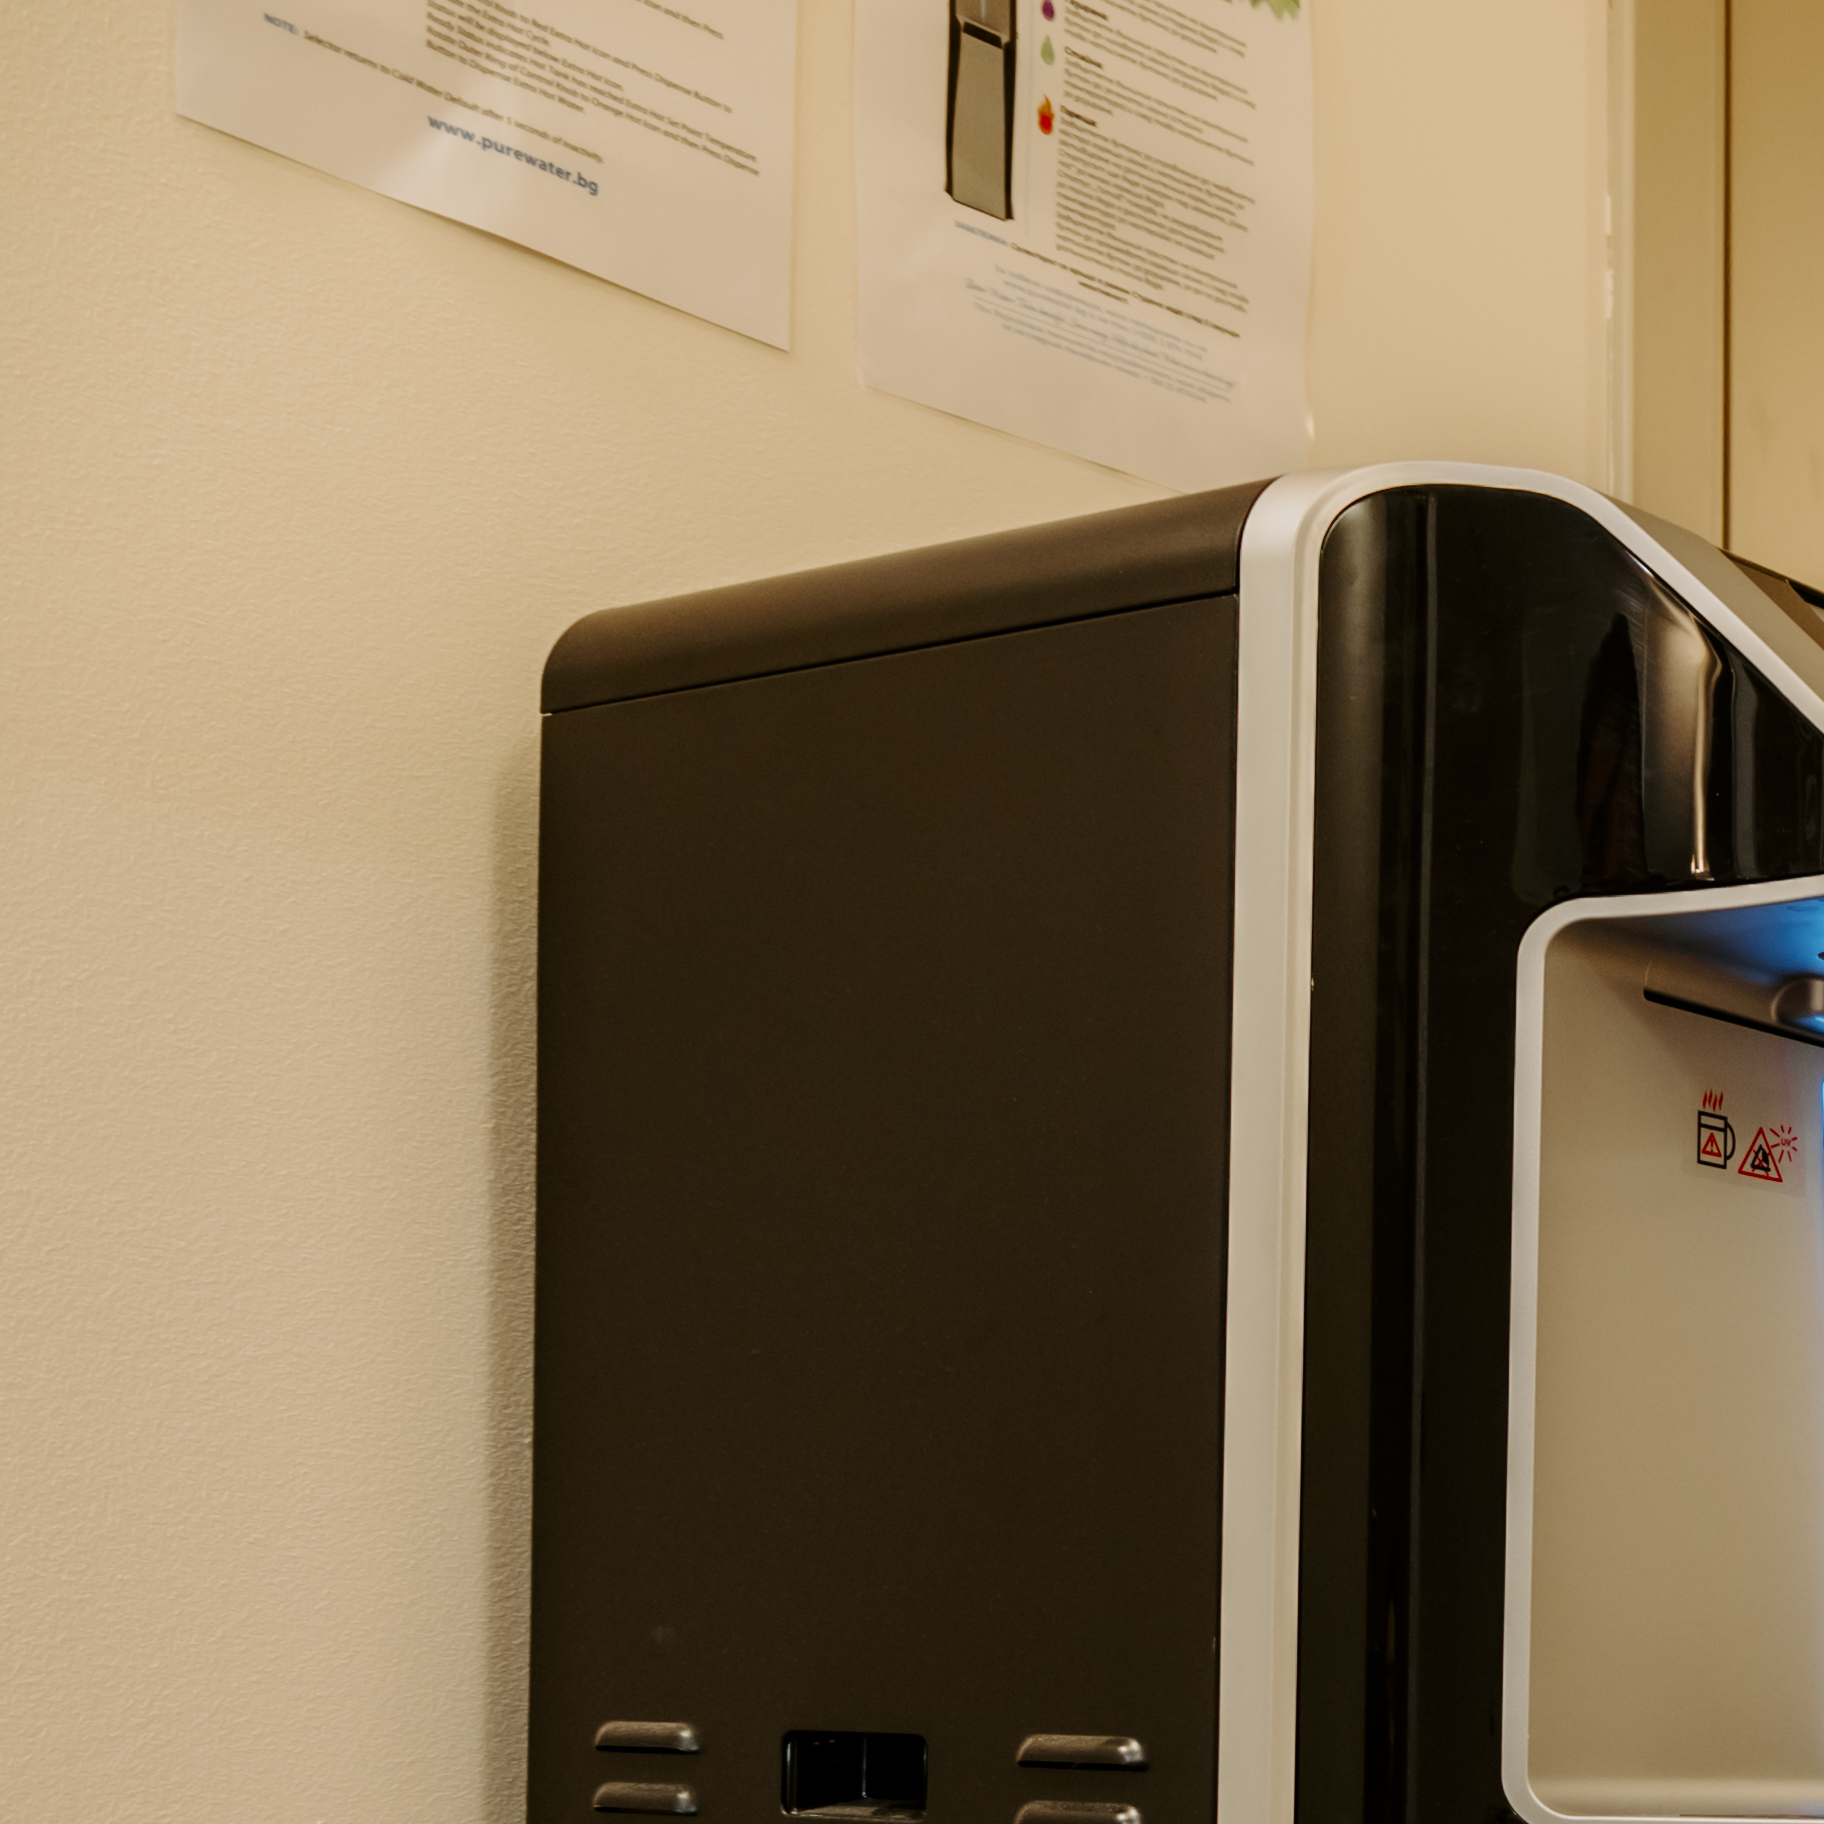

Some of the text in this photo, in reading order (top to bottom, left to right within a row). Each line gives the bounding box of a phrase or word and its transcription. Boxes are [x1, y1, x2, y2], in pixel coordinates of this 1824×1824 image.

[427, 114, 600, 197] www.purewater.bg
[506, 117, 512, 126] 5
[514, 120, 550, 141] seconds
[551, 135, 562, 146] of
